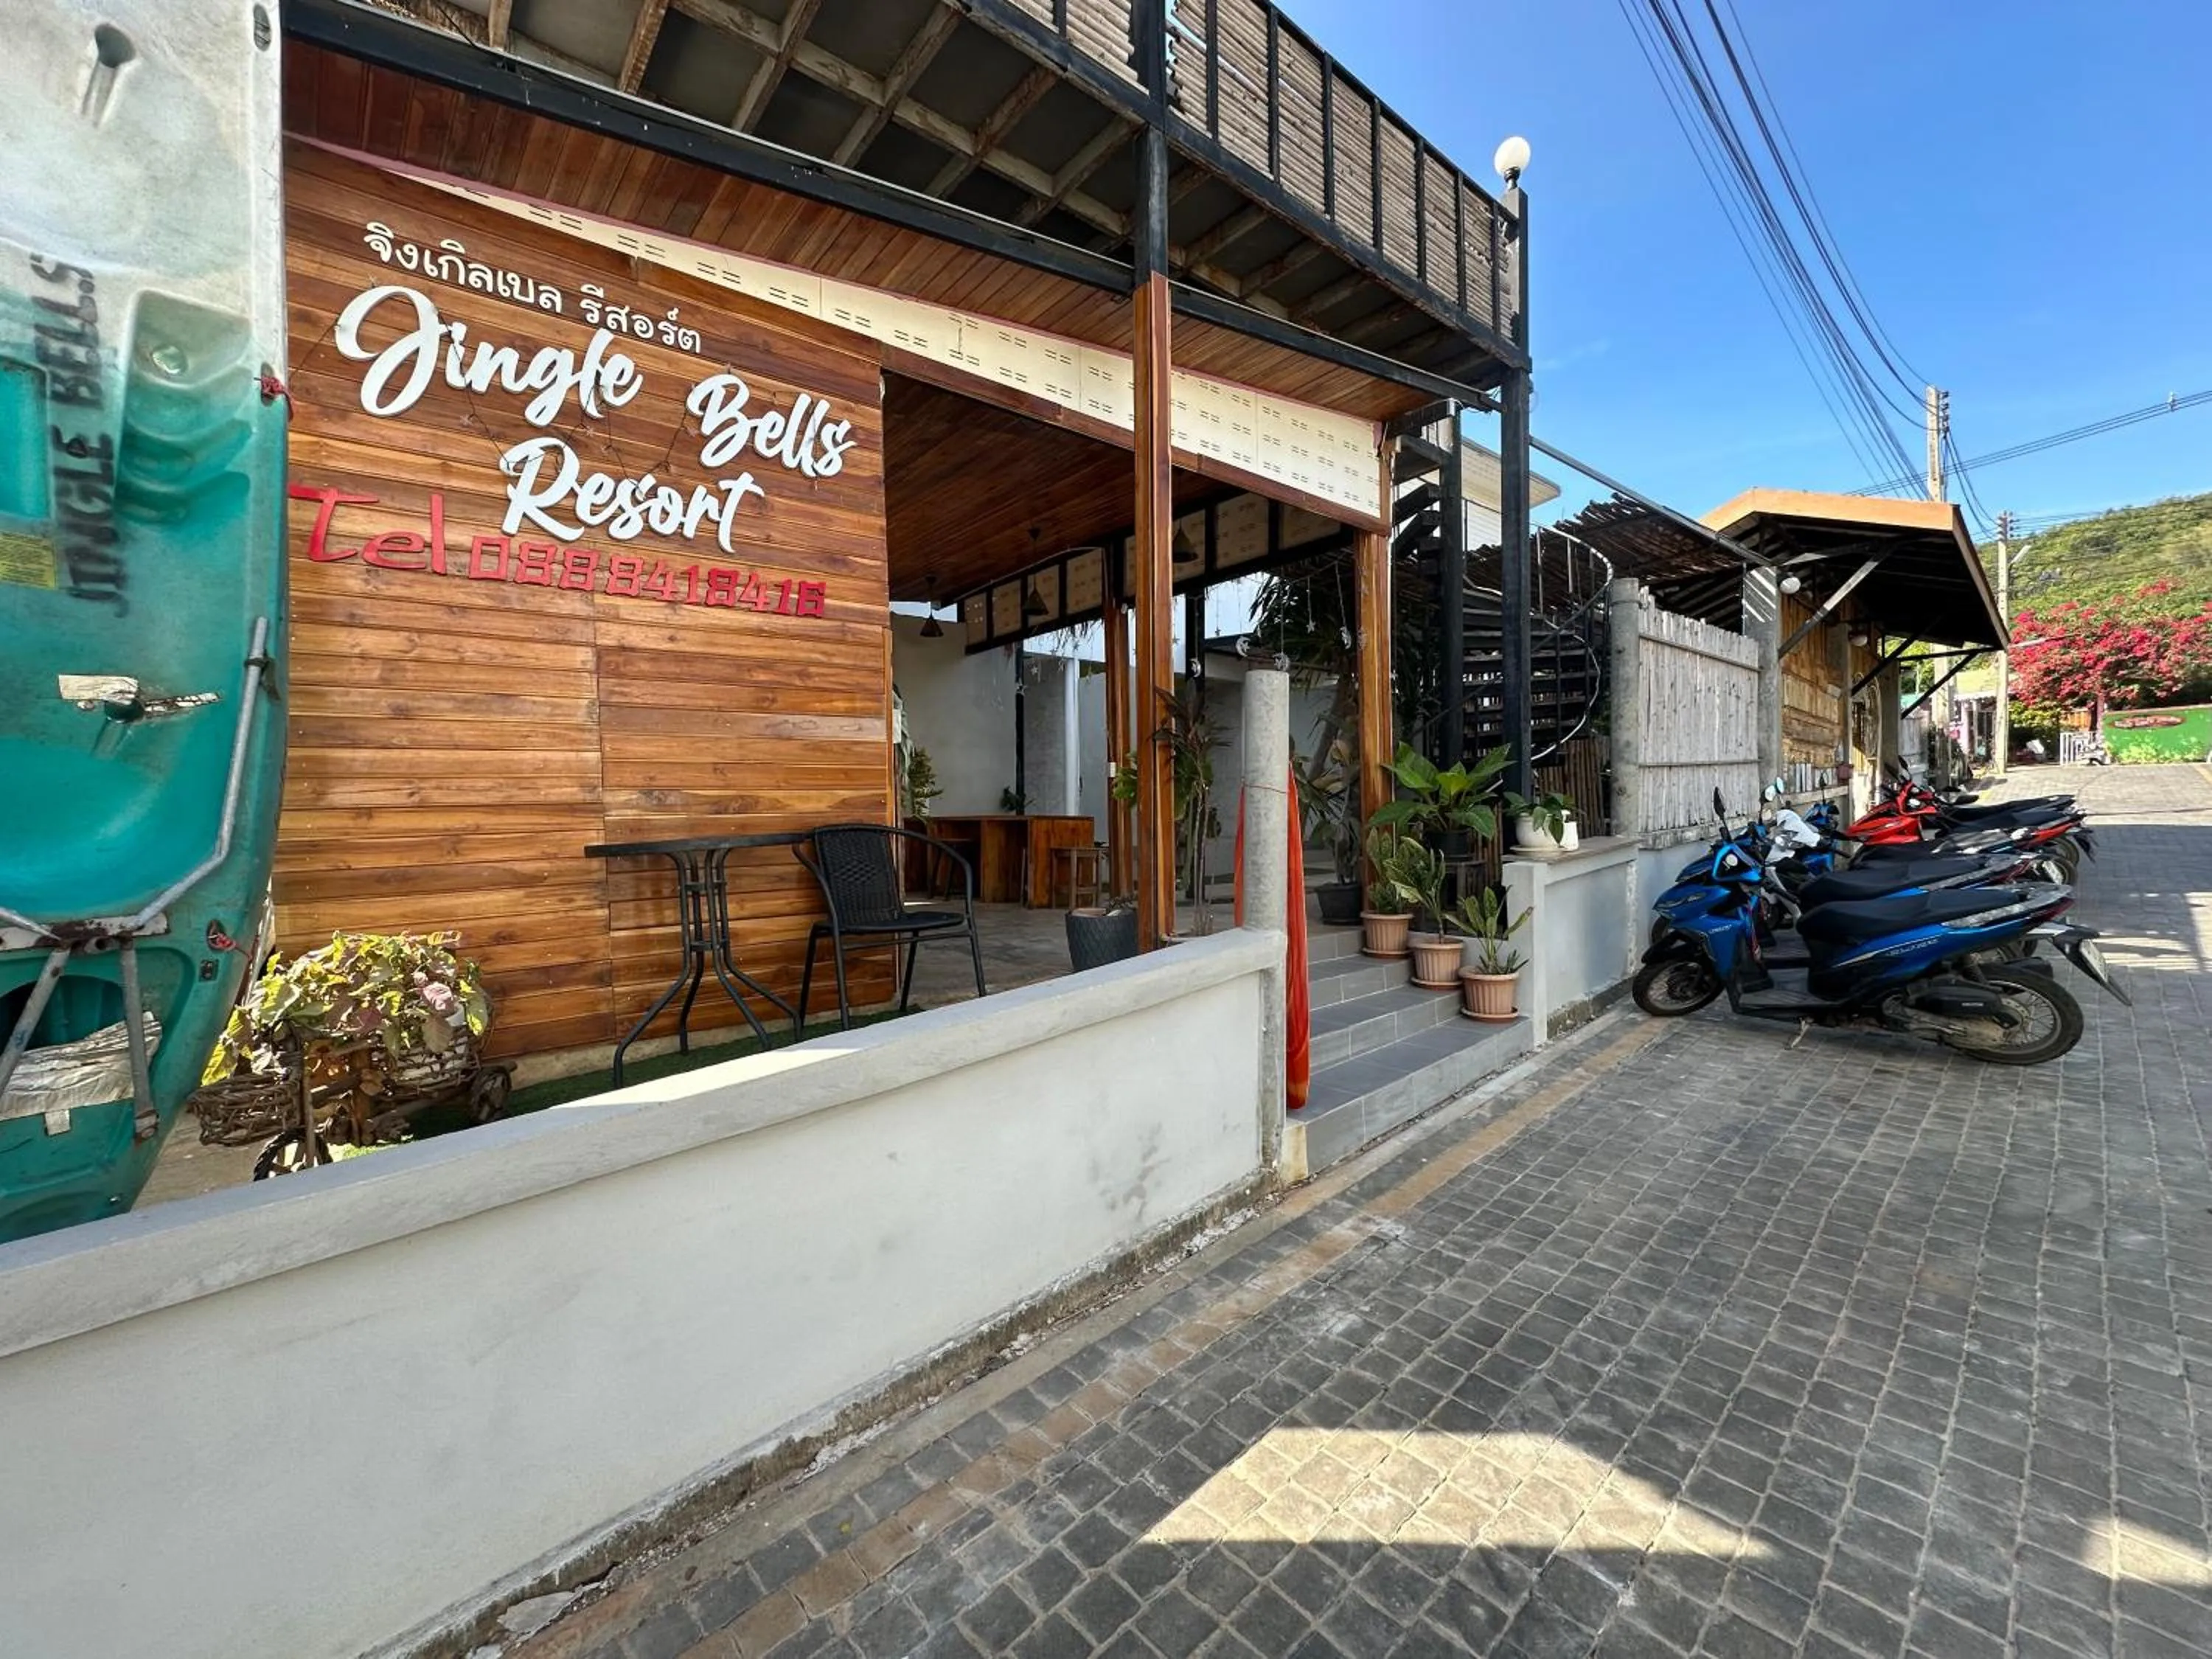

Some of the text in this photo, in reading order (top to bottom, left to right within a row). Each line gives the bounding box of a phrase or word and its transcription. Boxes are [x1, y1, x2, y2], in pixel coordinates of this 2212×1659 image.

[364, 221, 701, 353] จิงเกิลเบล รีสอร์ต
[334, 285, 856, 478] Jingle Bells
[288, 484, 448, 574] Tel
[499, 437, 765, 553] Resort
